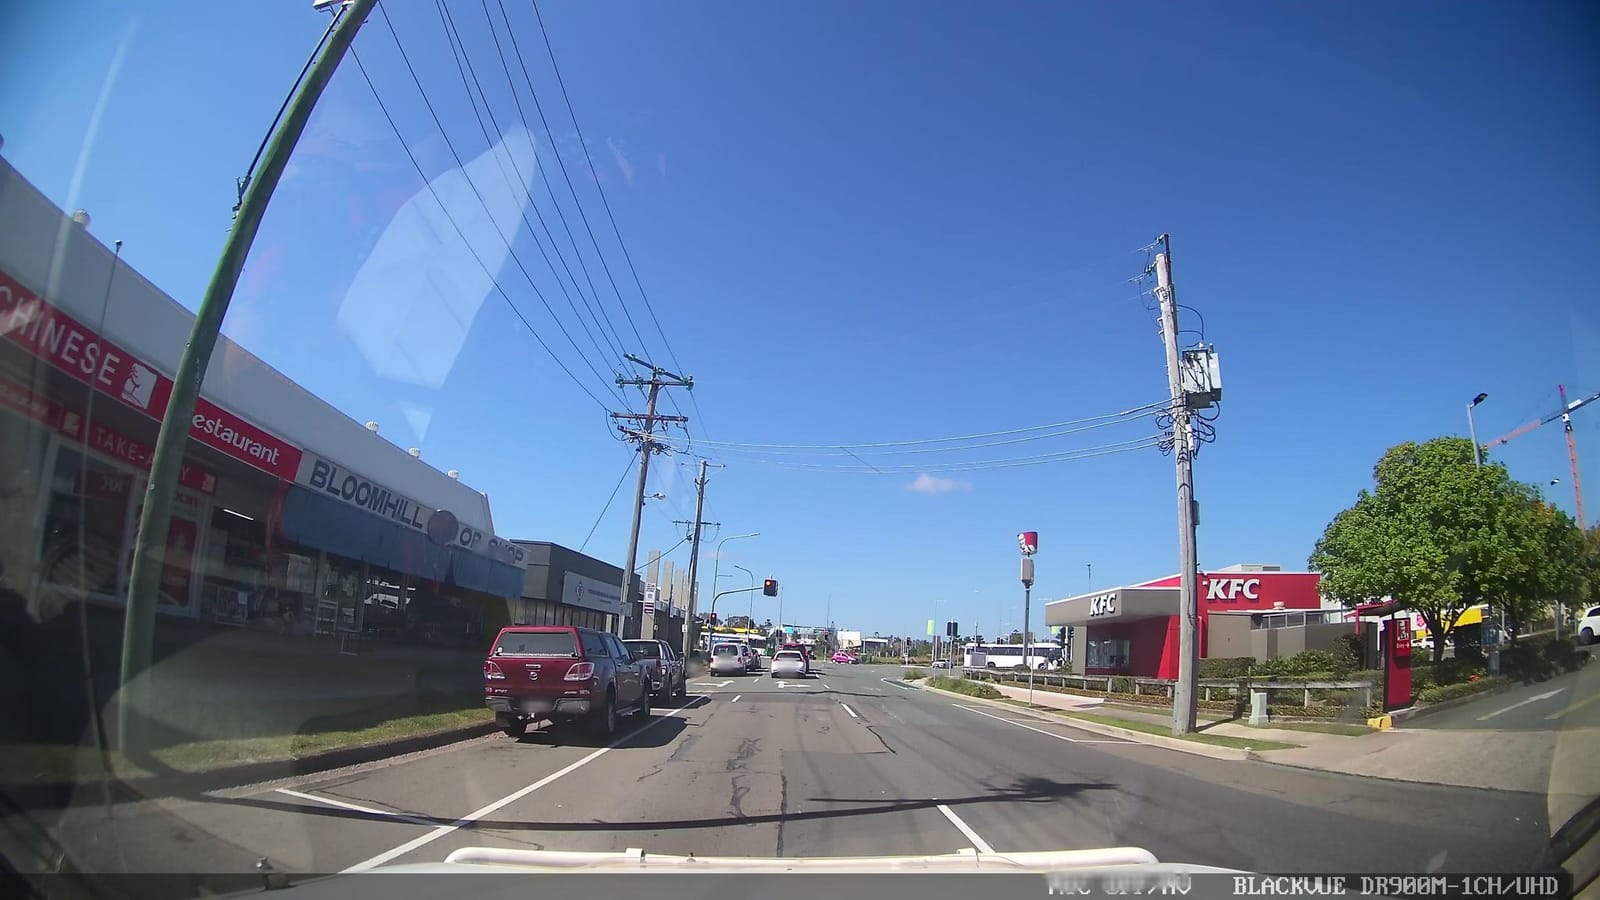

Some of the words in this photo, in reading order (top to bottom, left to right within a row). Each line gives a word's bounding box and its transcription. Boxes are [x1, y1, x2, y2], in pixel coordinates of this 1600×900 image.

[192, 413, 281, 466] estaurant
[309, 459, 423, 529] BLOOMHILL
[1089, 593, 1117, 617] KFC
[1205, 578, 1261, 600] KFC
